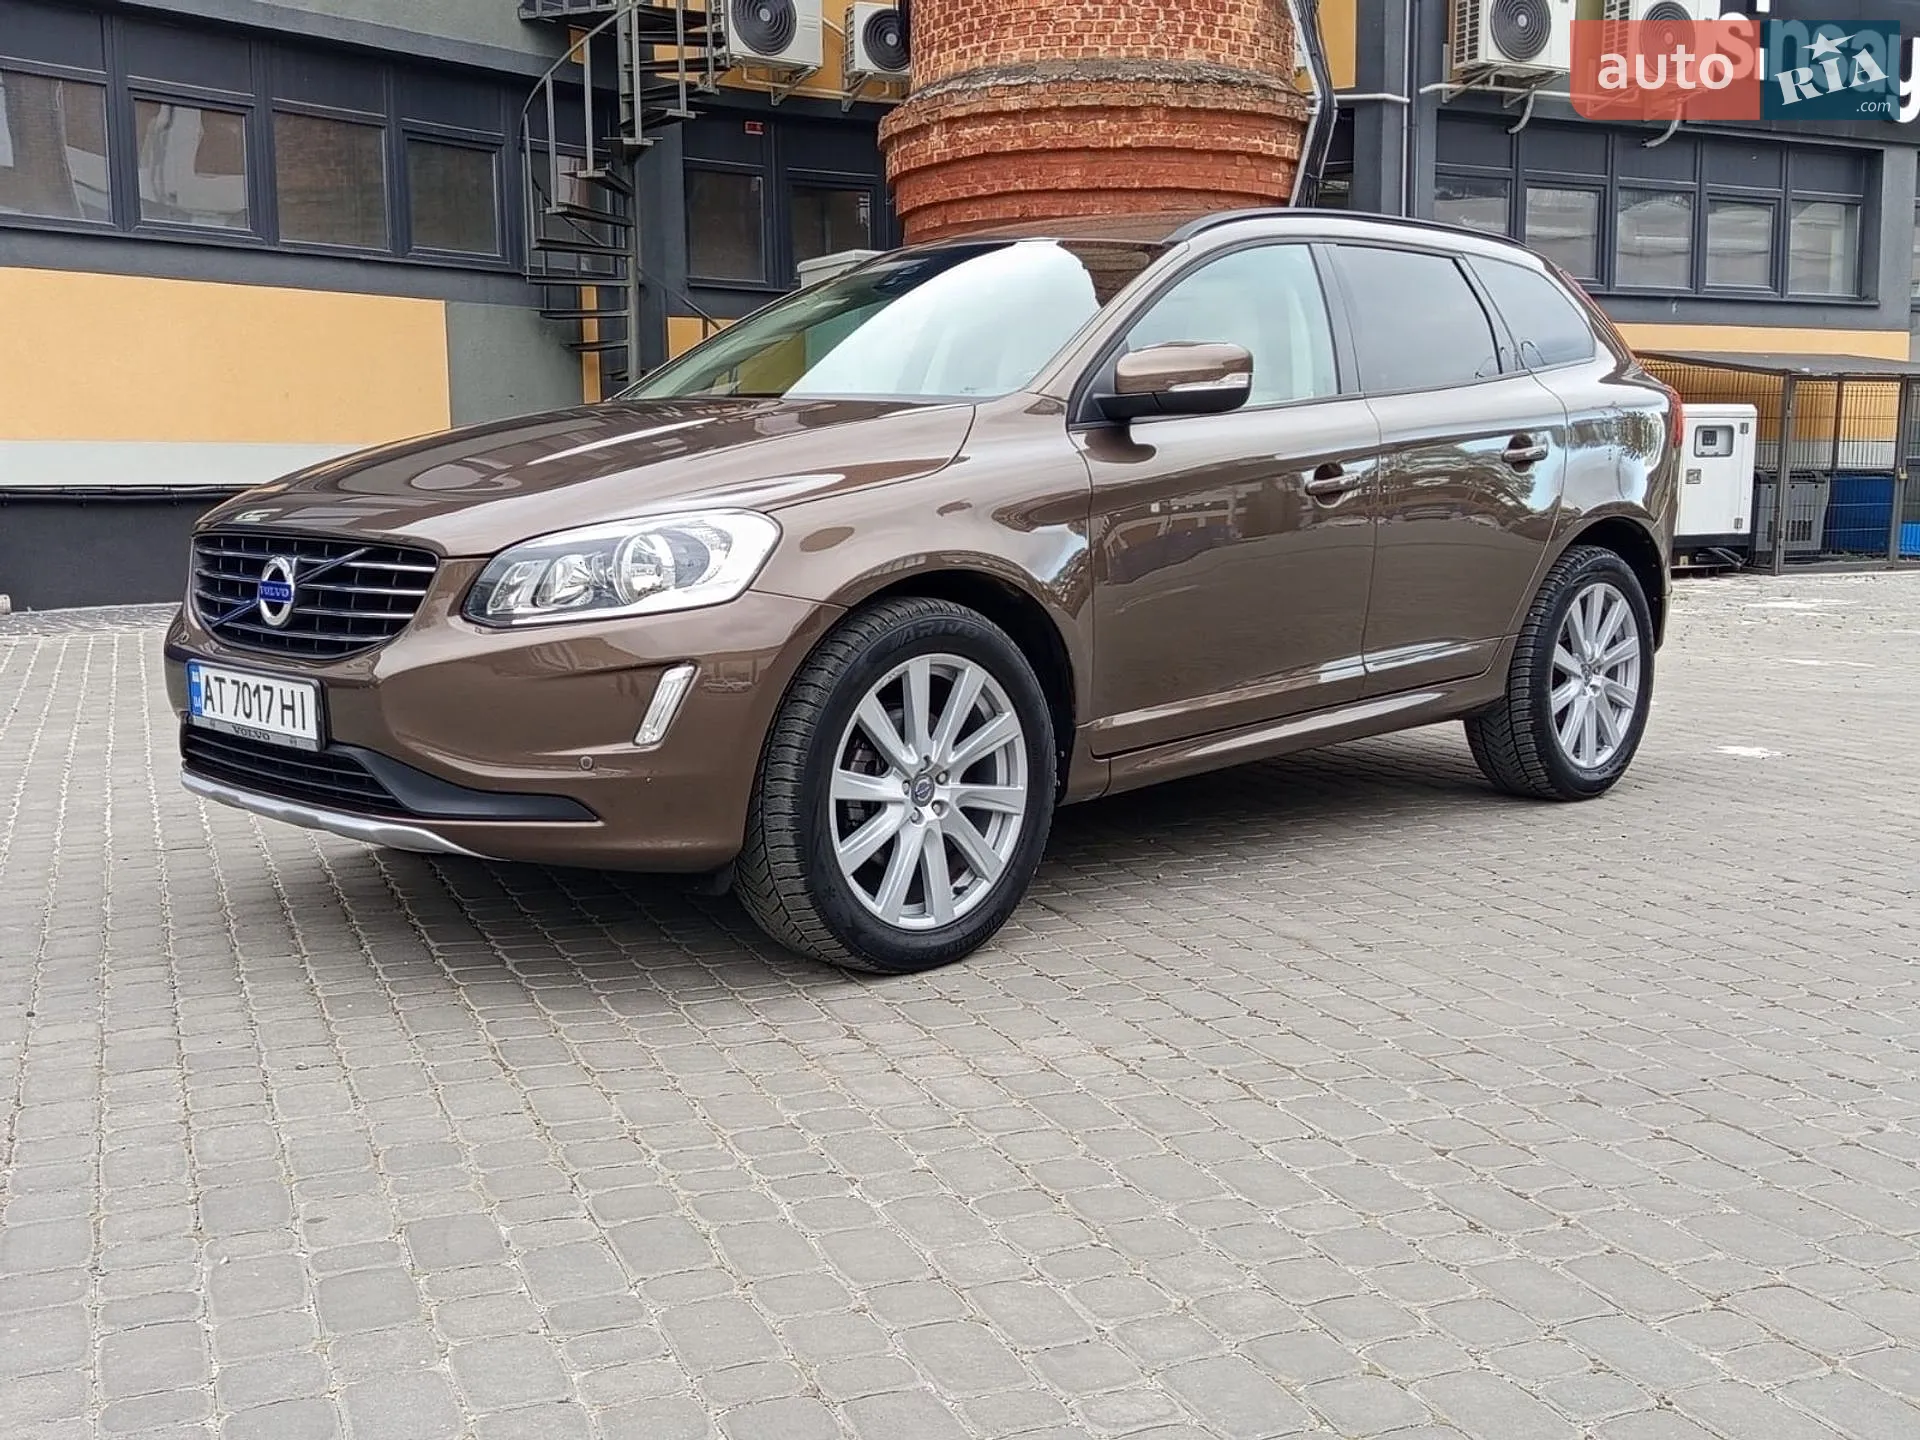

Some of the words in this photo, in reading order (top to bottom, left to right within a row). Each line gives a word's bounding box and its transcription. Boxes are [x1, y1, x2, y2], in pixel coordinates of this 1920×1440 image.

[260, 585, 290, 598] VOLVO
[203, 674, 226, 713] AT
[231, 679, 274, 724] 7017
[280, 687, 306, 731] HI
[231, 724, 271, 741] VOLVO
